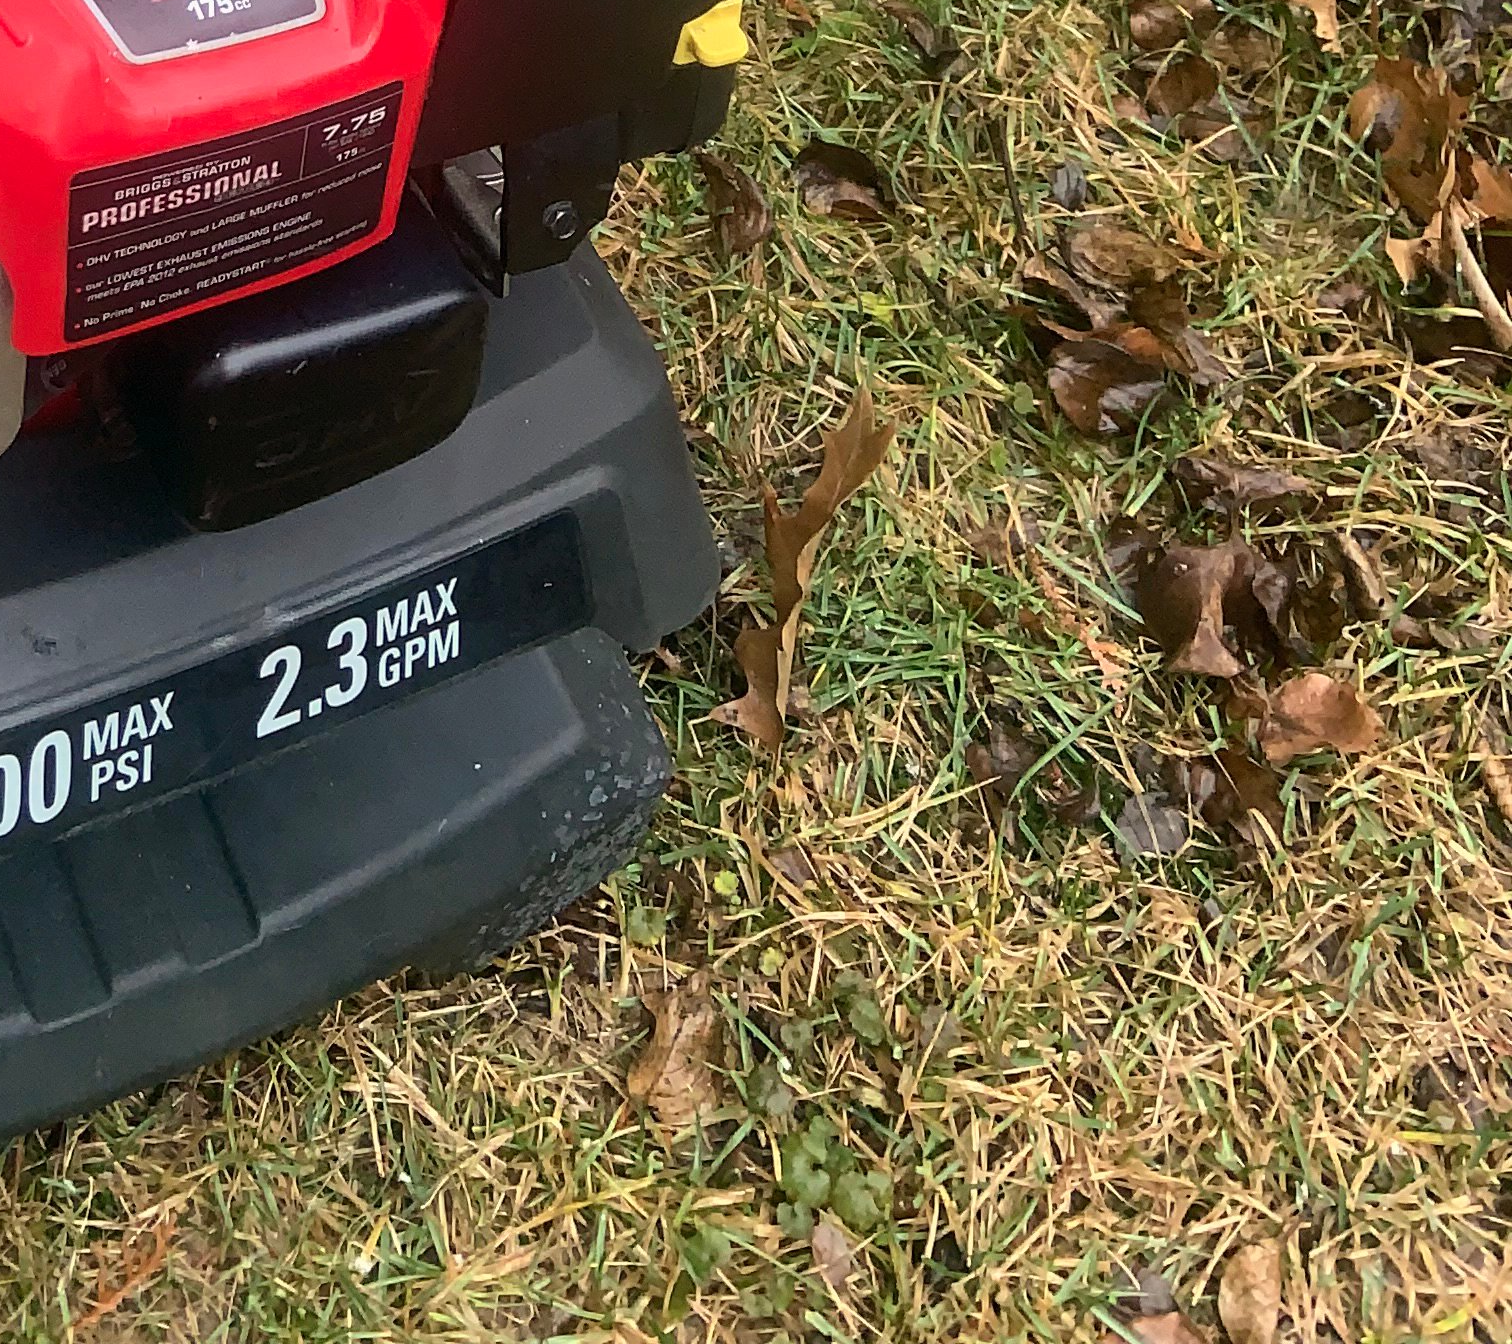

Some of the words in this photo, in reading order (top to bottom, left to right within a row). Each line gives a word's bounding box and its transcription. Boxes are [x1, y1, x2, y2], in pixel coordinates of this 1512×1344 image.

[322, 106, 386, 141] 7.75
[81, 160, 283, 233] PROFESSIONAL
[114, 230, 187, 259] TECHNOLOGY
[211, 210, 245, 231] LARGE
[249, 194, 298, 217] MUFFLER
[107, 262, 154, 285] LOWEST
[156, 247, 209, 270] EXHAUST
[211, 226, 270, 253] EMISSIONS
[273, 211, 312, 231] ENGINE
[84, 316, 100, 328] No
[140, 297, 156, 310] No
[123, 279, 145, 292] EPA
[374, 576, 459, 648] MAX
[255, 616, 368, 739] 2.3
[377, 619, 462, 691] GPM
[82, 691, 176, 762] MAX
[90, 743, 154, 804] PSI
